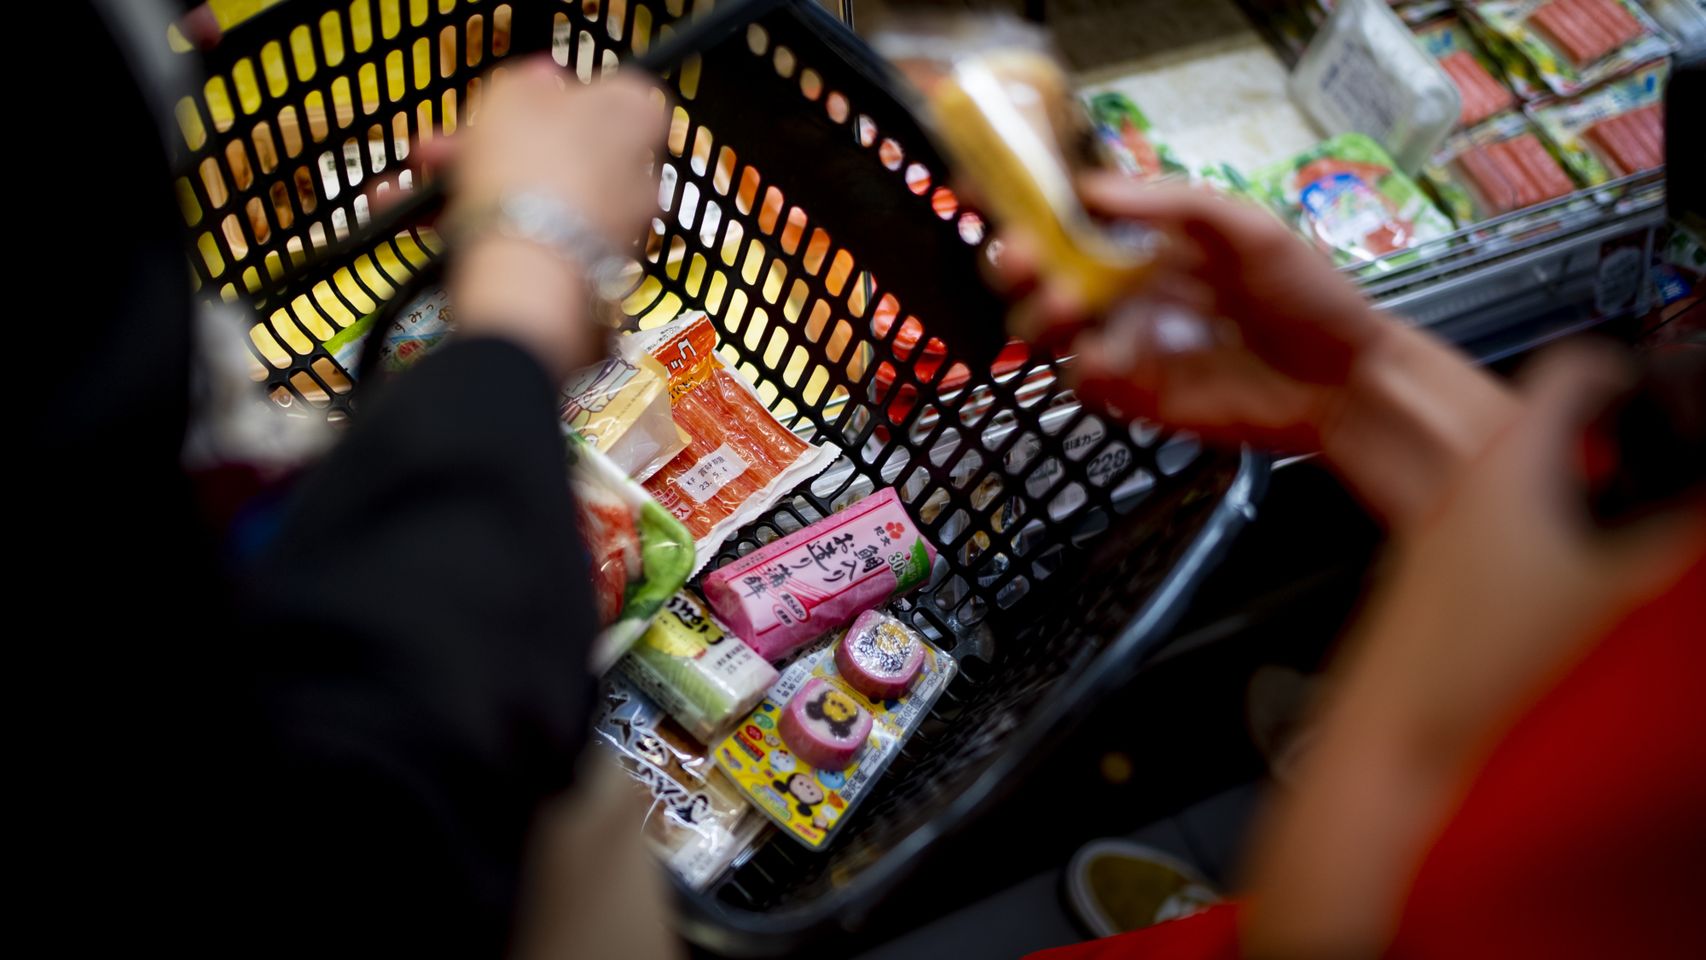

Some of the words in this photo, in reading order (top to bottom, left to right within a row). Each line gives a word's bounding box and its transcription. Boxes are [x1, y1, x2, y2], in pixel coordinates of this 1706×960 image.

[873, 526, 891, 547] 紀文
[741, 532, 854, 599] お造り蒲鉾
[823, 544, 885, 583] 鯛入り
